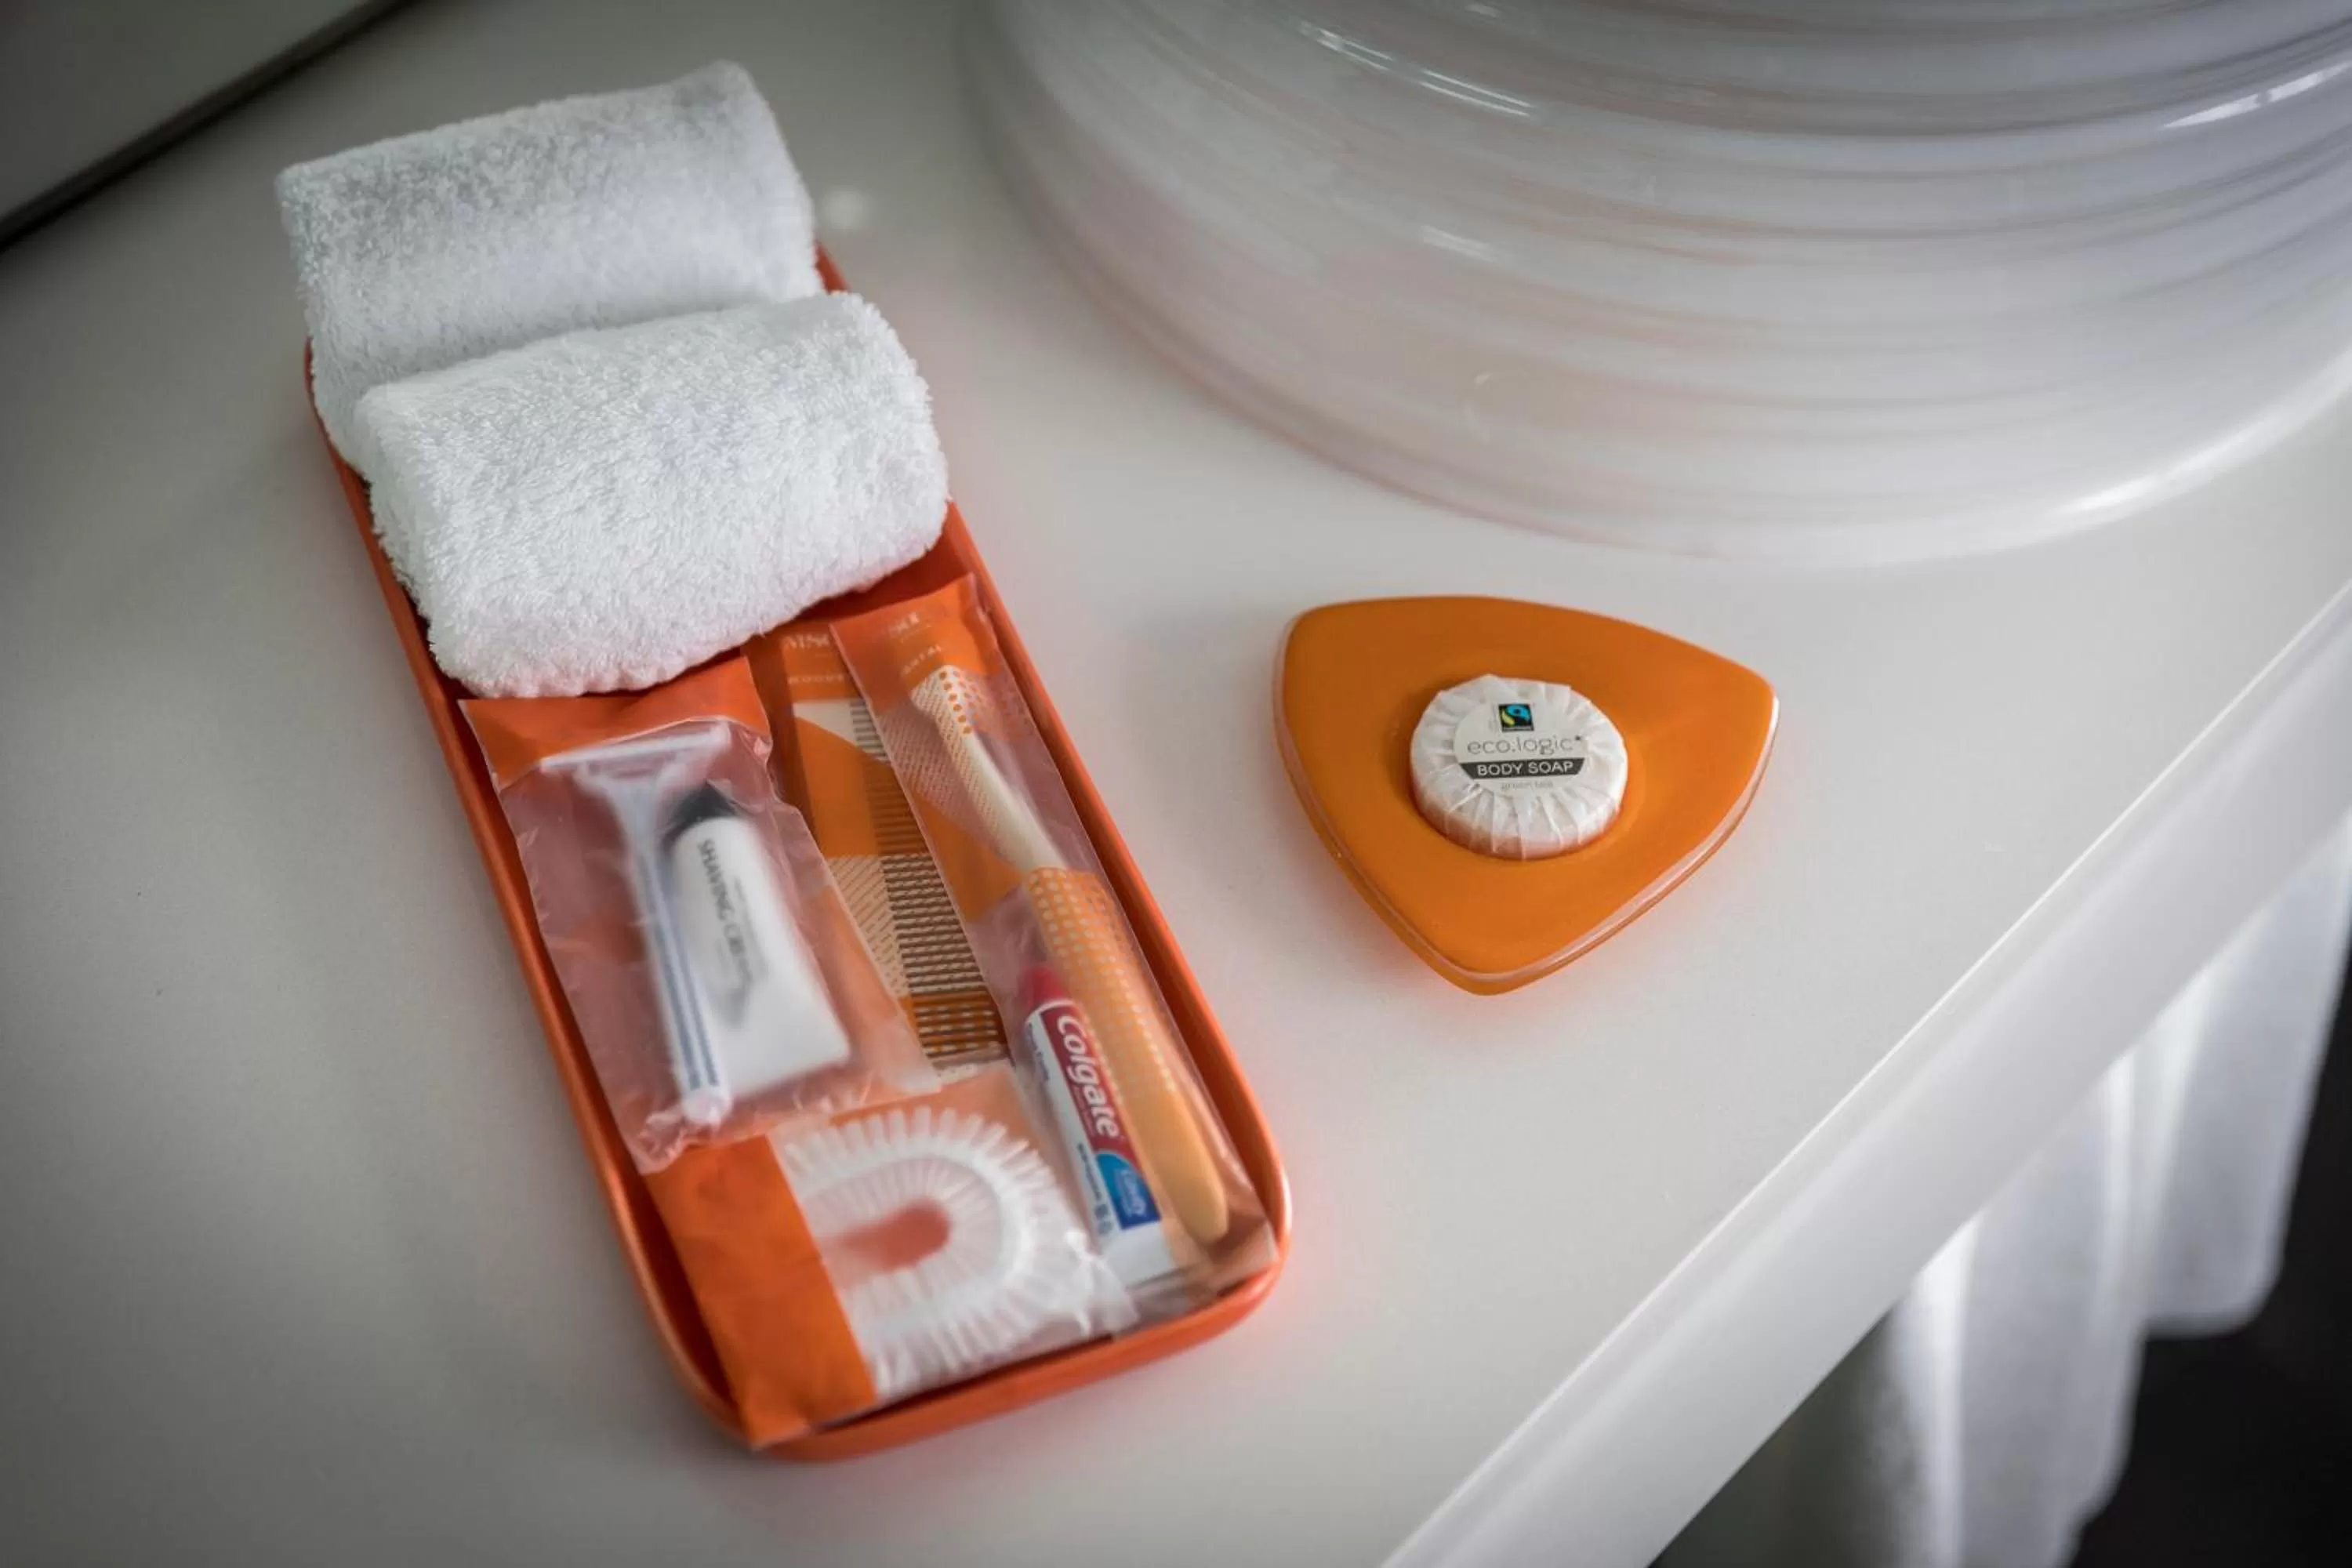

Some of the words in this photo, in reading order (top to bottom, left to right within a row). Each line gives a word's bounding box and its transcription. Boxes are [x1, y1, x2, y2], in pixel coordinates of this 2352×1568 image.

[1477, 762, 1523, 776] BODY
[1528, 760, 1573, 774] SOAP
[697, 838, 735, 922] SHAVING
[1057, 1015, 1120, 1138] Colgate
